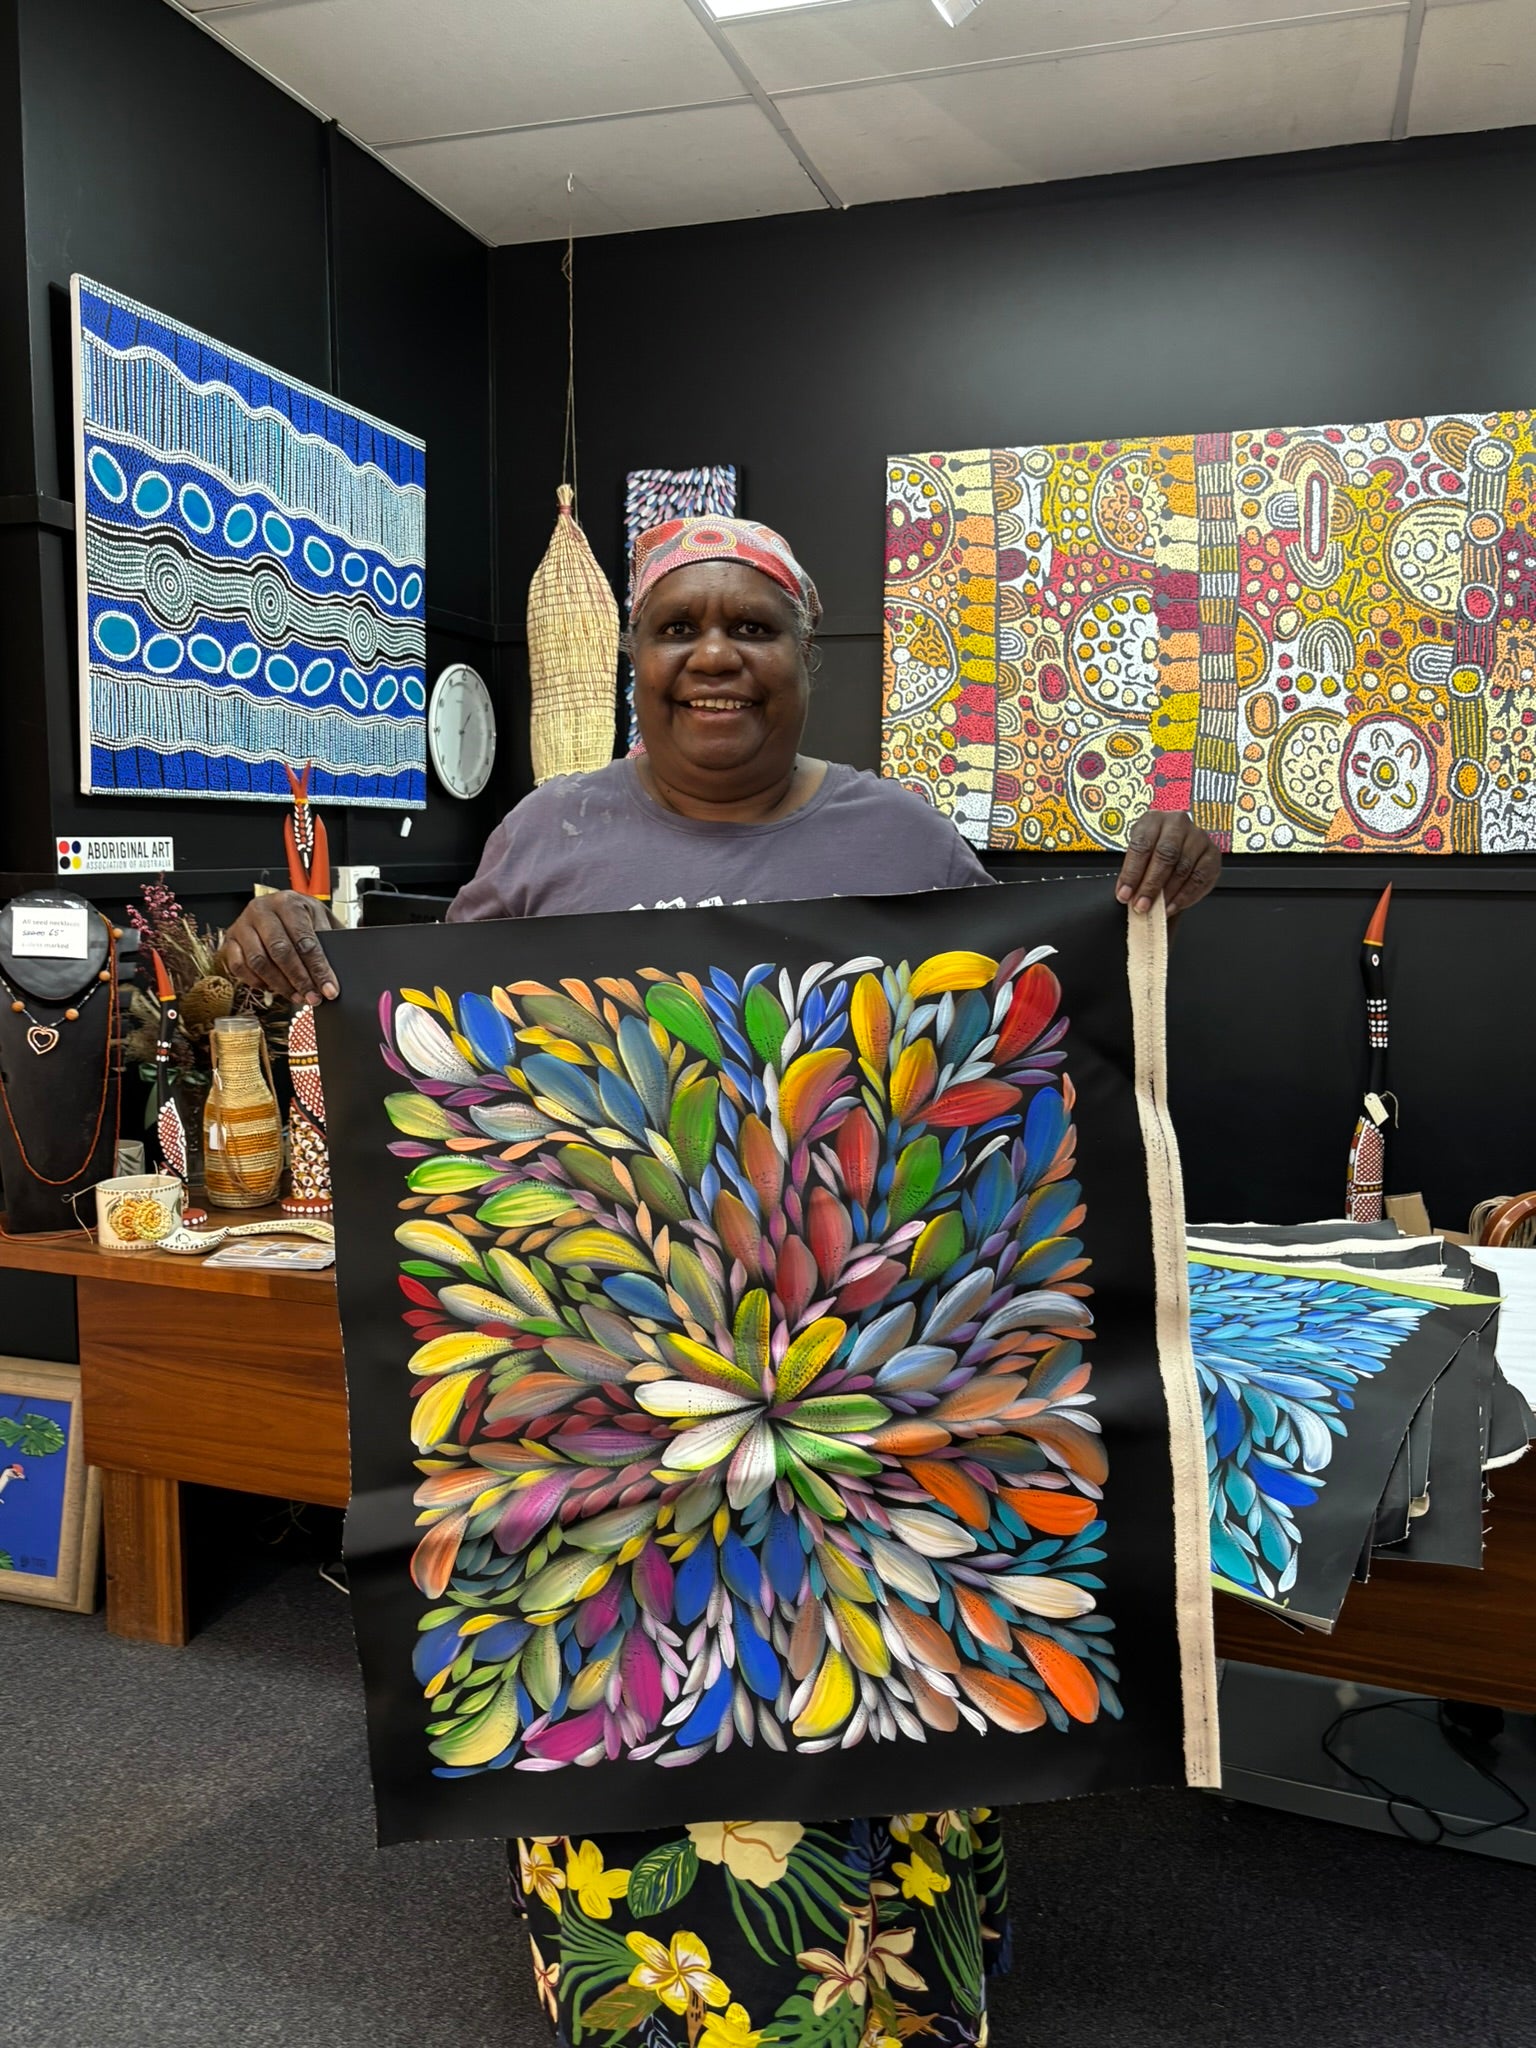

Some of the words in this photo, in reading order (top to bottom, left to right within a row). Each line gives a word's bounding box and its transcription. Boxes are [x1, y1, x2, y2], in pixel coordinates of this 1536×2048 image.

[87, 841, 149, 860] ABORIGINAL
[151, 841, 171, 859] ART
[86, 860, 127, 870] ASSOCIATION
[129, 860, 137, 869] OF
[138, 859, 172, 869] AUSTRALIA
